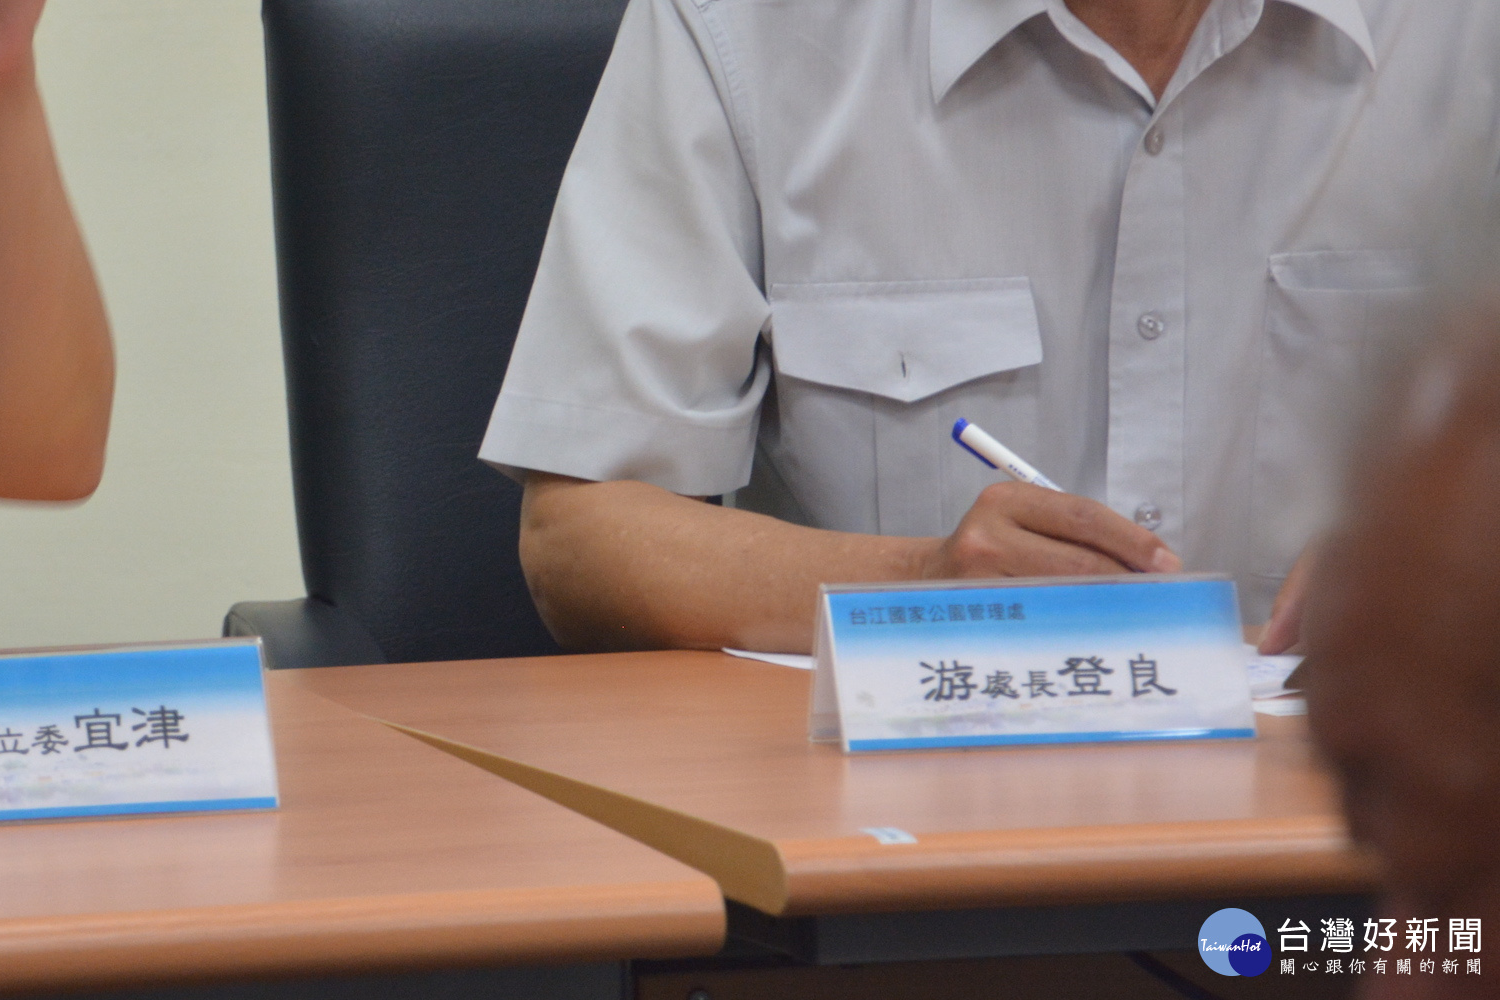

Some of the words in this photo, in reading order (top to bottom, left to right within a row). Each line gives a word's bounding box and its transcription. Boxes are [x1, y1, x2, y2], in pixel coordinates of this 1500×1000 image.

[850, 603, 1026, 625] 台江國家公園管理處
[919, 653, 1178, 701] 游處長登良
